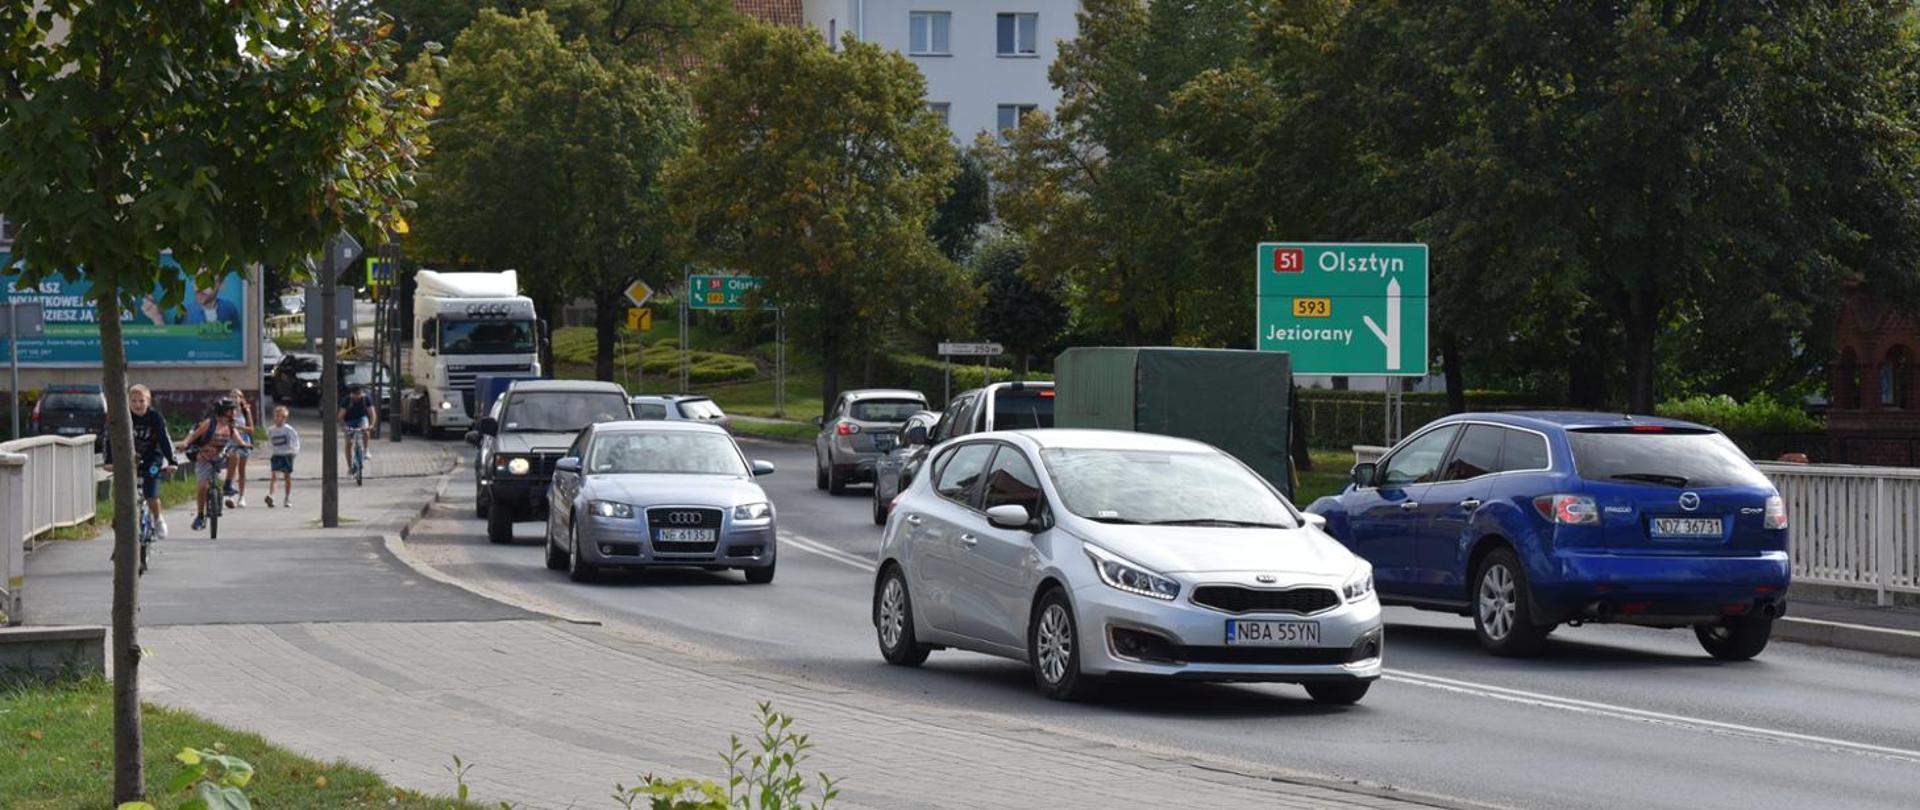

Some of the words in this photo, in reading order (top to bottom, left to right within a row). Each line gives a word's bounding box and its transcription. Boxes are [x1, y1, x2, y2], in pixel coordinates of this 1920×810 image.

[1280, 253, 1297, 269] 51
[1318, 251, 1404, 278] Olsztyn
[1299, 301, 1326, 314] 593
[1266, 324, 1353, 345] Jeziorany
[1656, 519, 1680, 534] NDZ
[1684, 519, 1721, 534] 36731
[1238, 623, 1272, 640] NBA
[1278, 623, 1316, 641] 55YN
